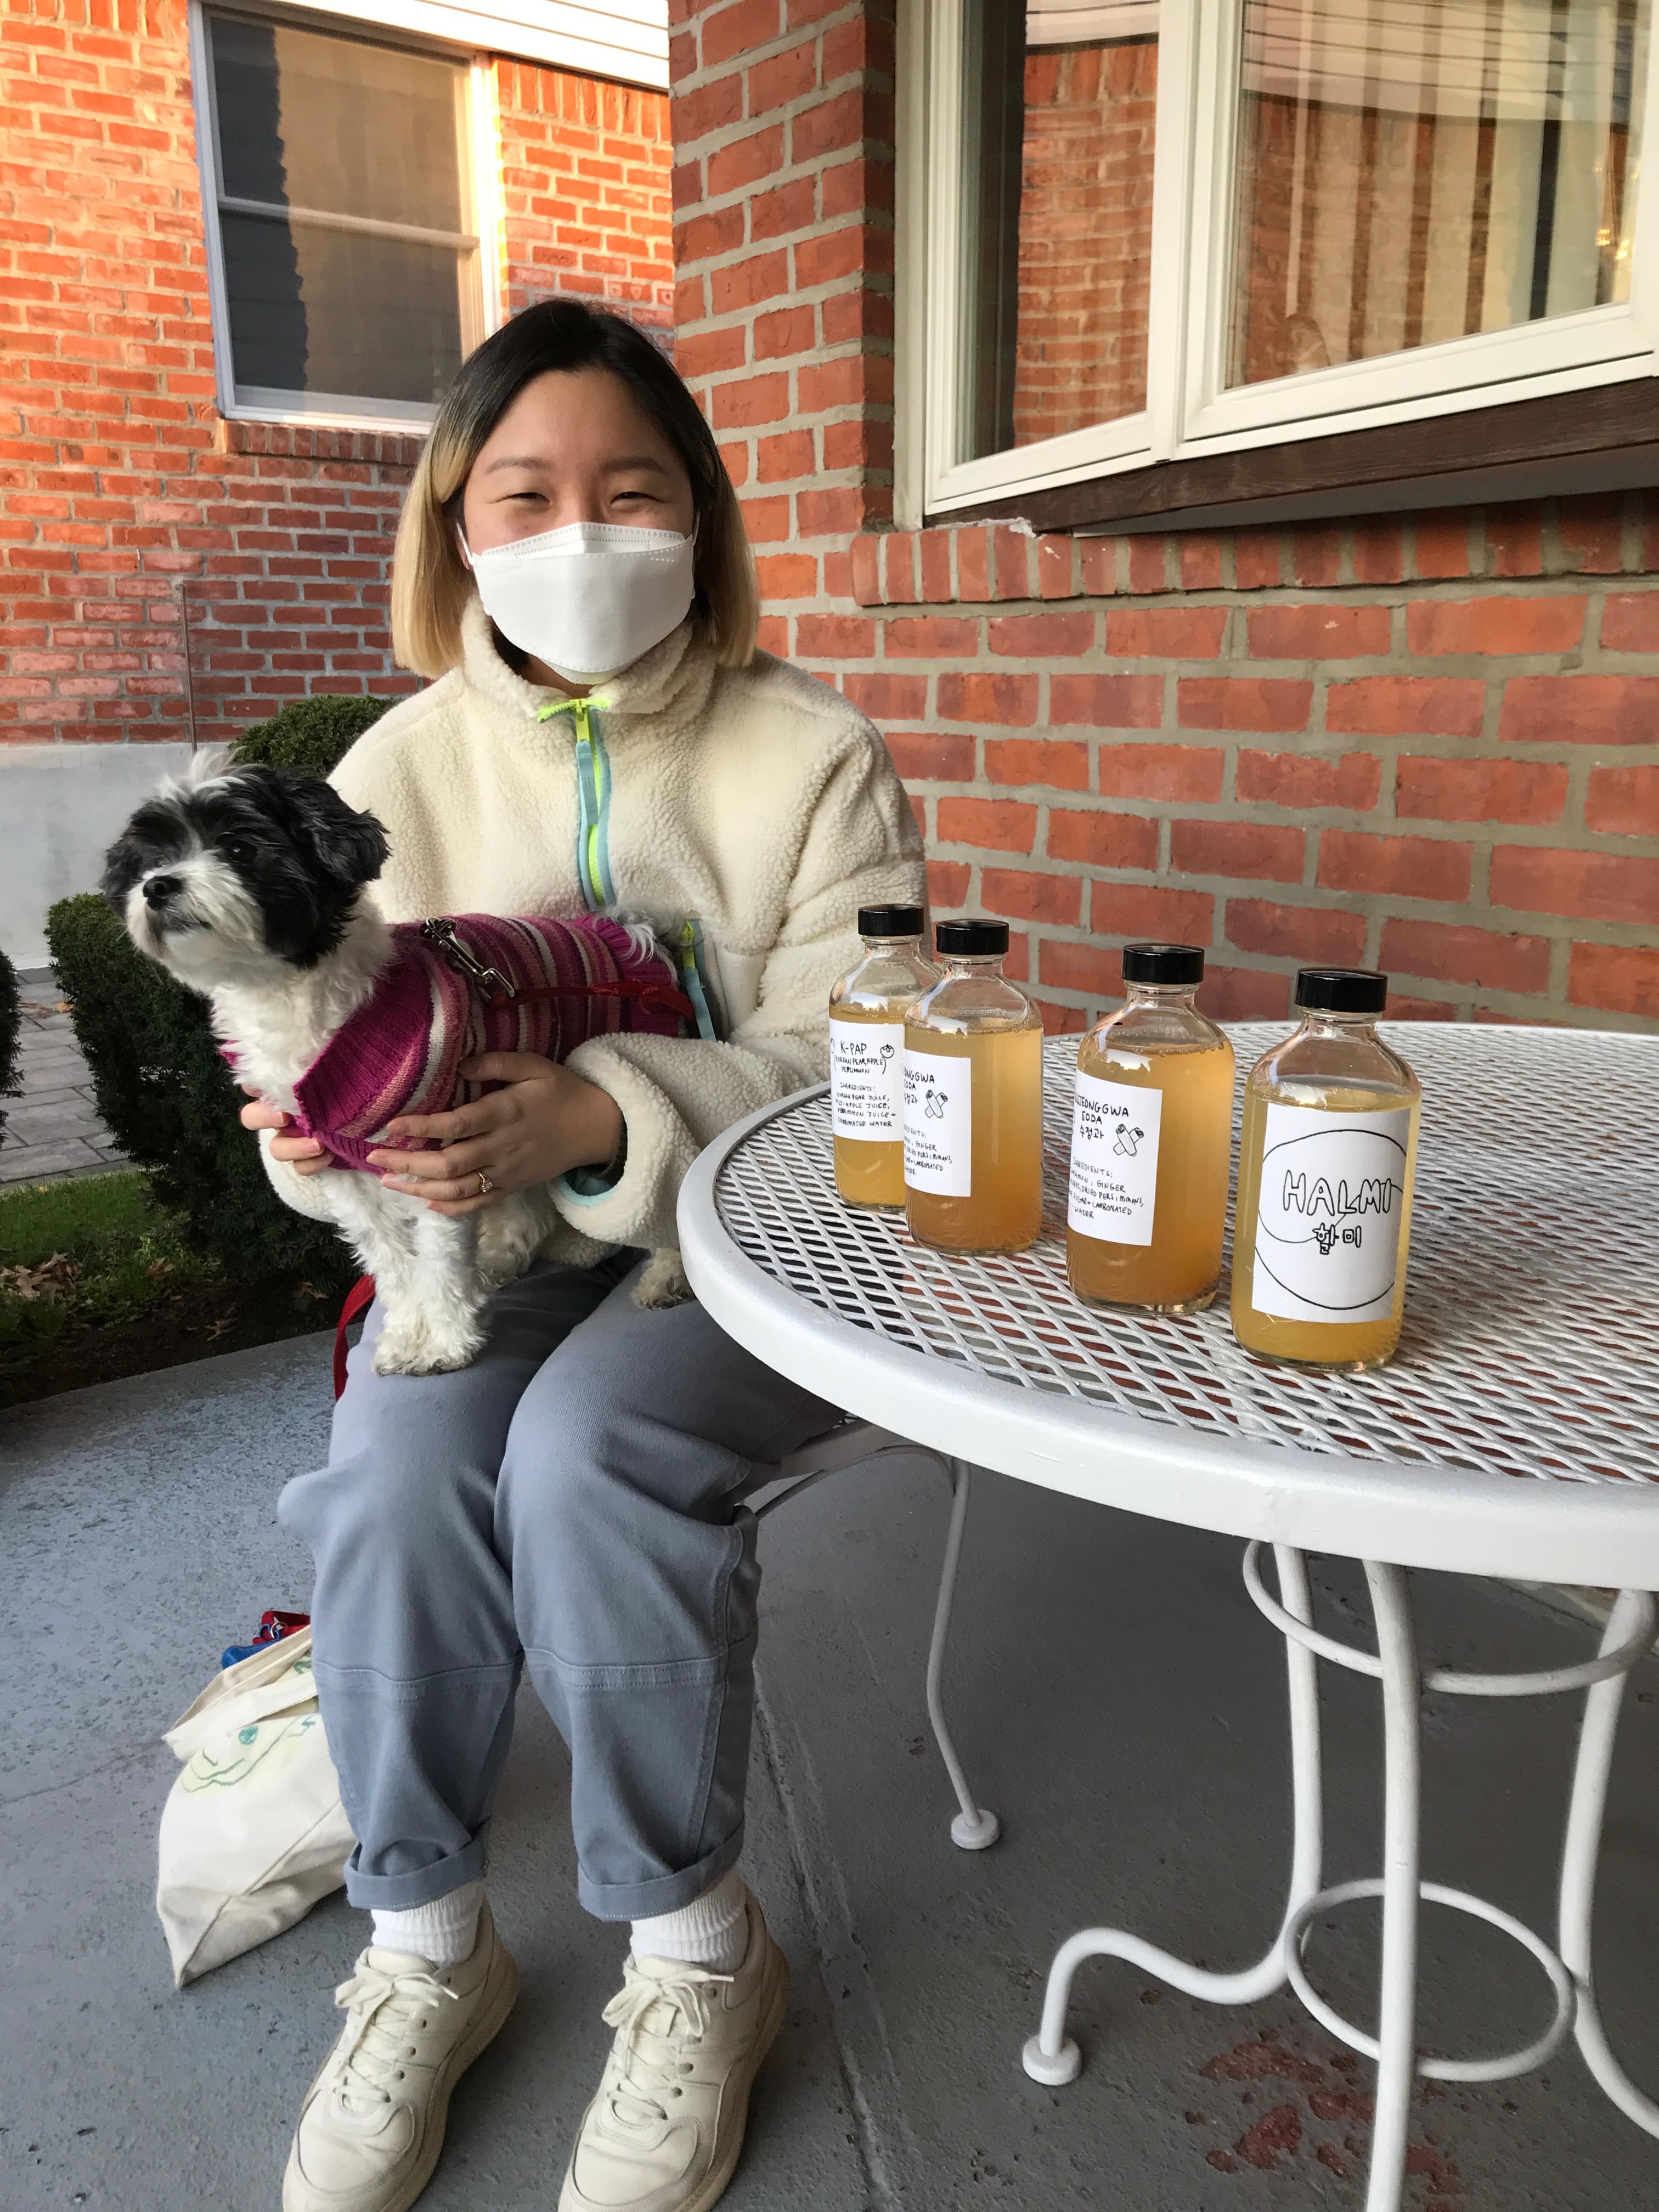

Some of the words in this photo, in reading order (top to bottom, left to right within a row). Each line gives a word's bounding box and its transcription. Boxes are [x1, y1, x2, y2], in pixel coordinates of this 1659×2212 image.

[840, 1040, 867, 1055] K-PAP
[838, 1117, 866, 1127] CARBONATED
[1081, 1110, 1102, 1125] SODA
[1080, 1124, 1104, 1140] 수정과
[916, 1140, 937, 1152] GINGER
[1097, 1180, 1126, 1193] GINGER
[1283, 1170, 1392, 1217] HALMI
[1074, 1206, 1094, 1219] WATER
[1312, 1222, 1362, 1255] 할미
